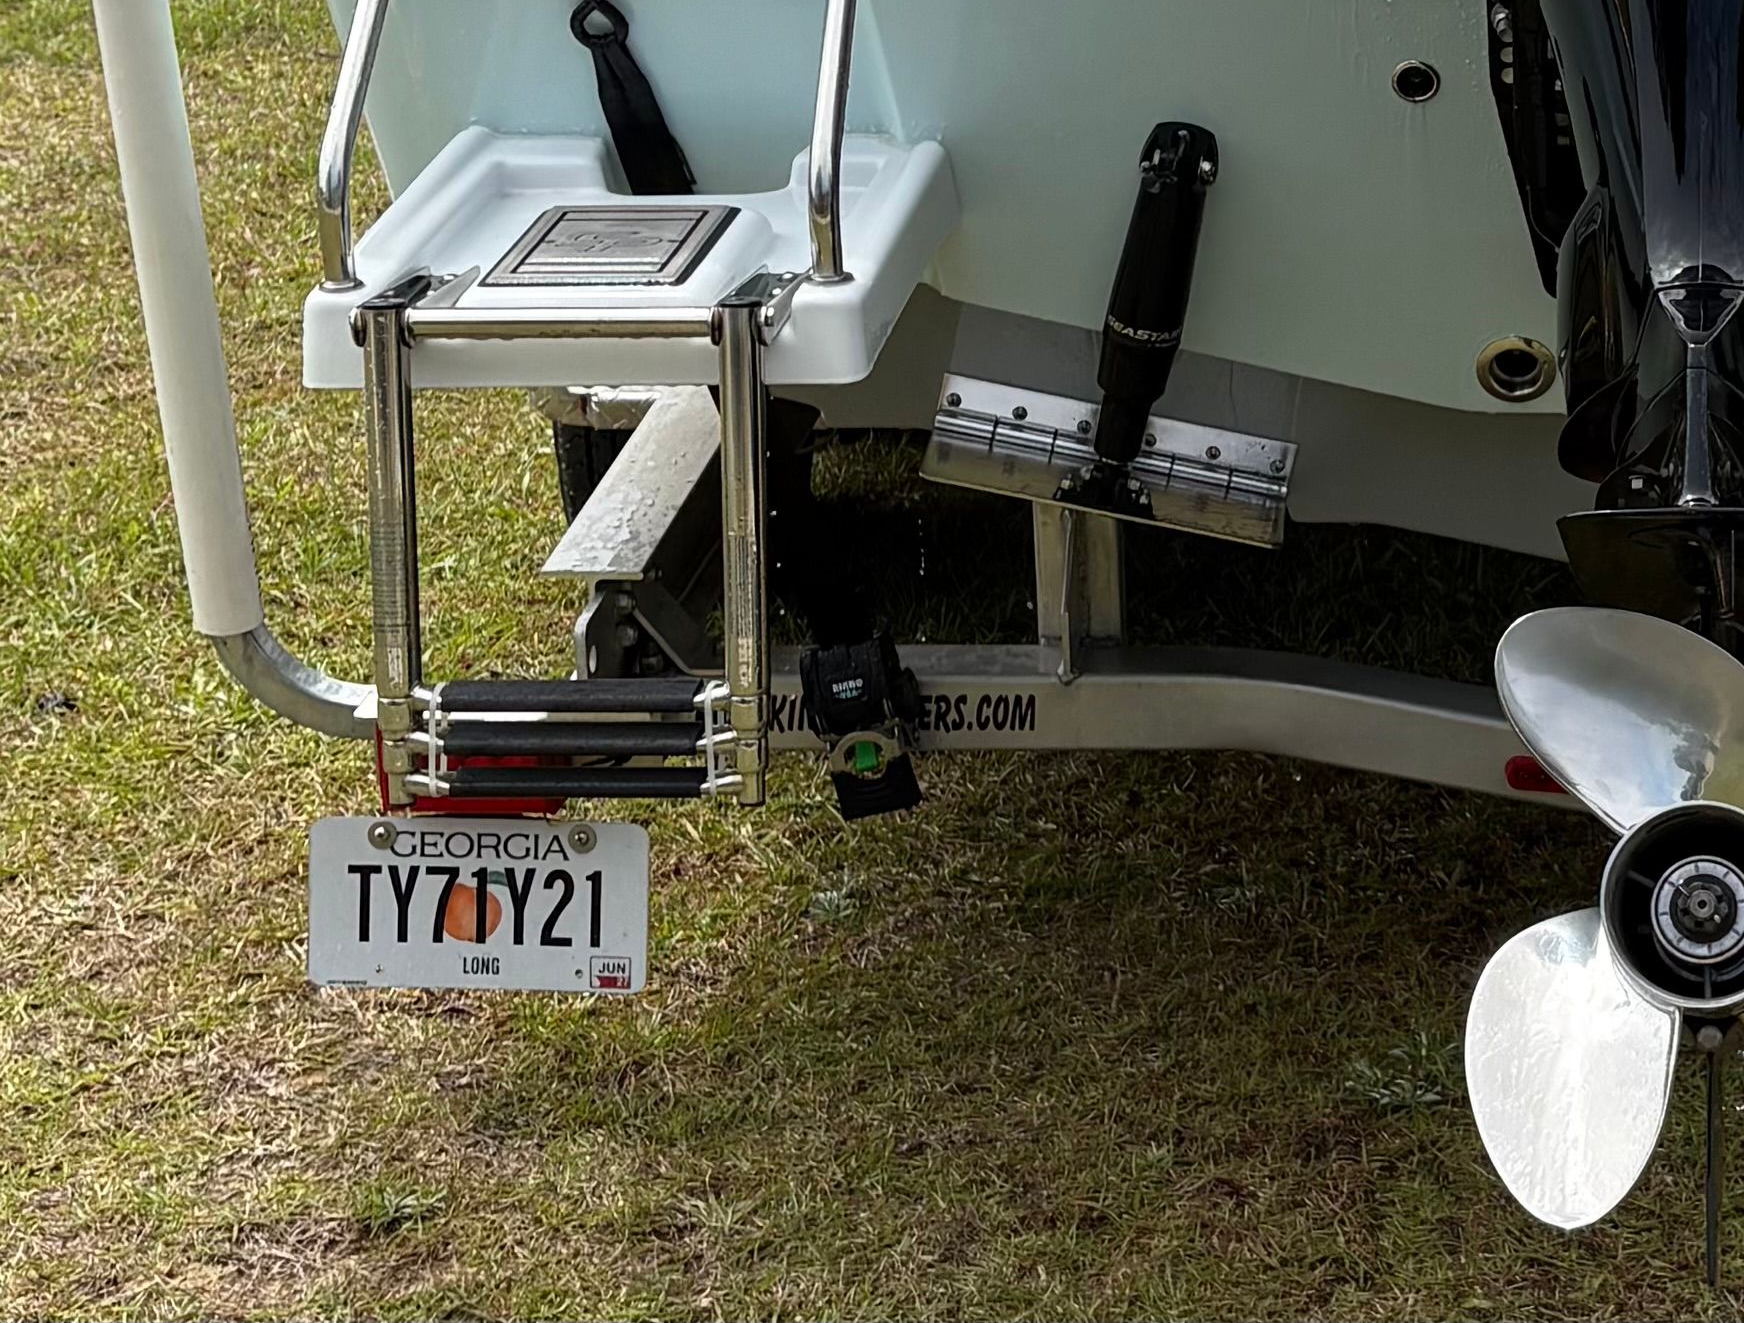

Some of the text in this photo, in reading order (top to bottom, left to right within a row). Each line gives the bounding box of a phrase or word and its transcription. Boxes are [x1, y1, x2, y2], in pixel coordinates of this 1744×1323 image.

[389, 829, 570, 861] GEORGIA
[347, 864, 603, 948] TY71Y21
[462, 956, 501, 976] LONG
[598, 961, 626, 975] JUN
